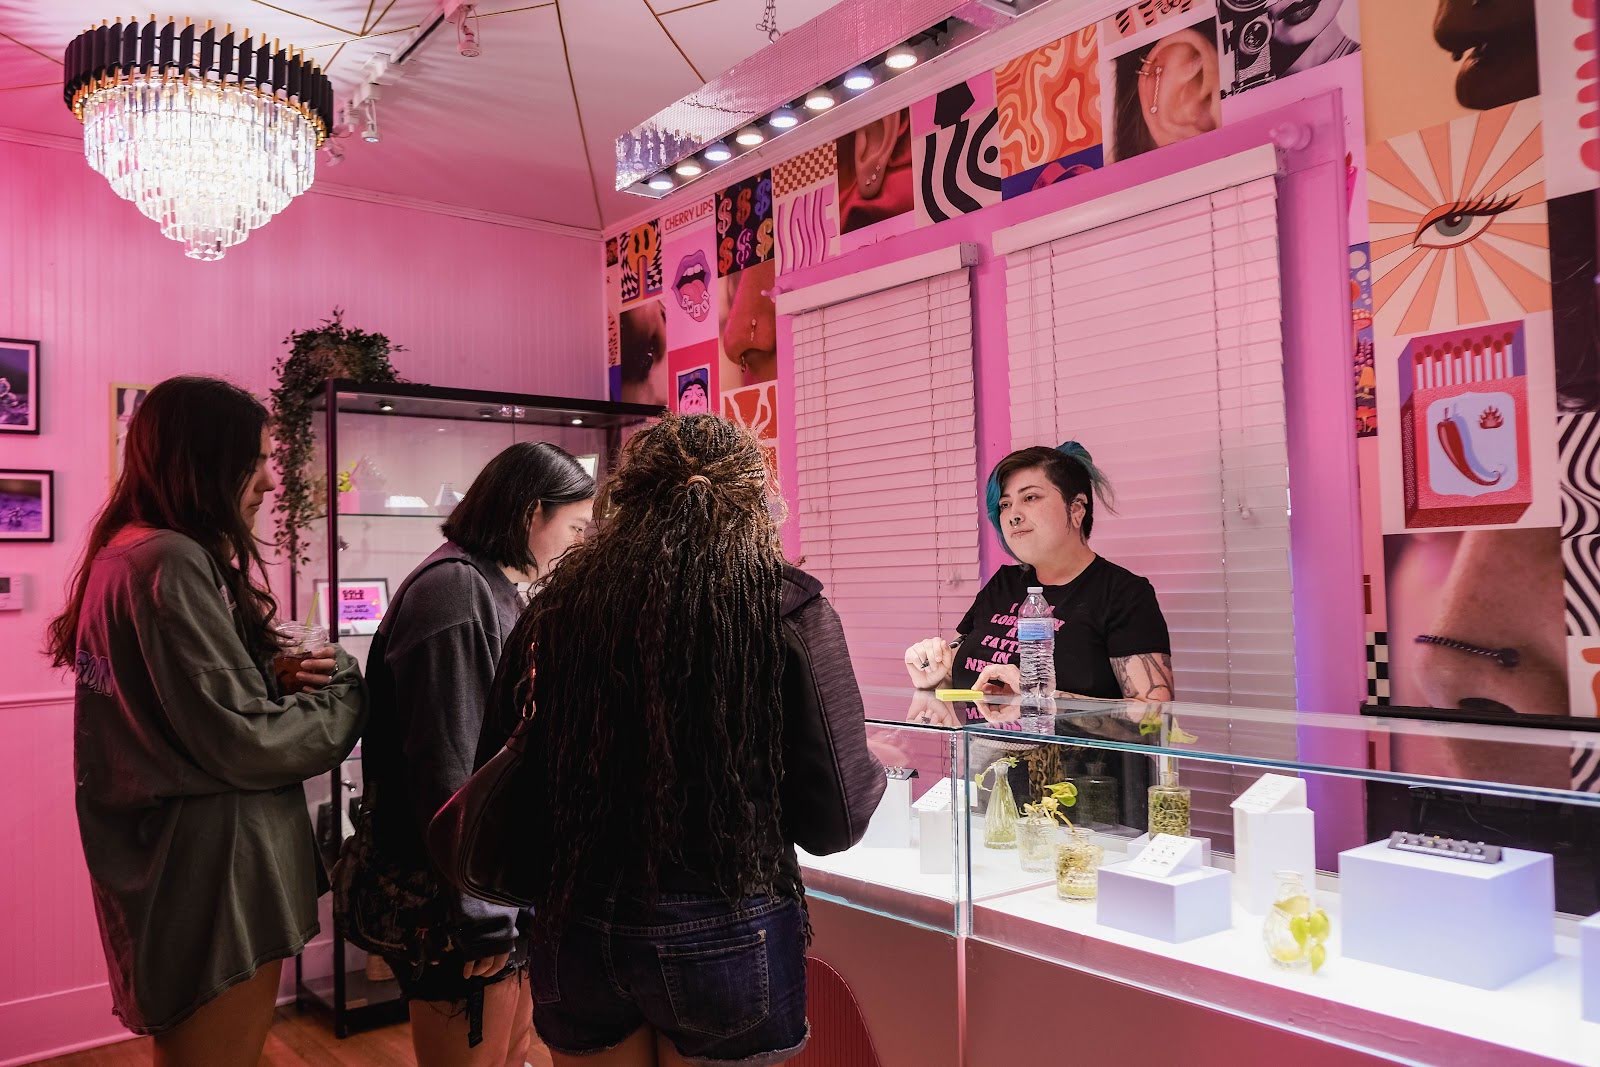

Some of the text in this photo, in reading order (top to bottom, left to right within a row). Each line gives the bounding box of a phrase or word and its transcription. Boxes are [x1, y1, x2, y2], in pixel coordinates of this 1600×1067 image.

[664, 198, 714, 231] CHERRY LIPS
[777, 183, 837, 276] LOVE
[991, 651, 1012, 665] IN
